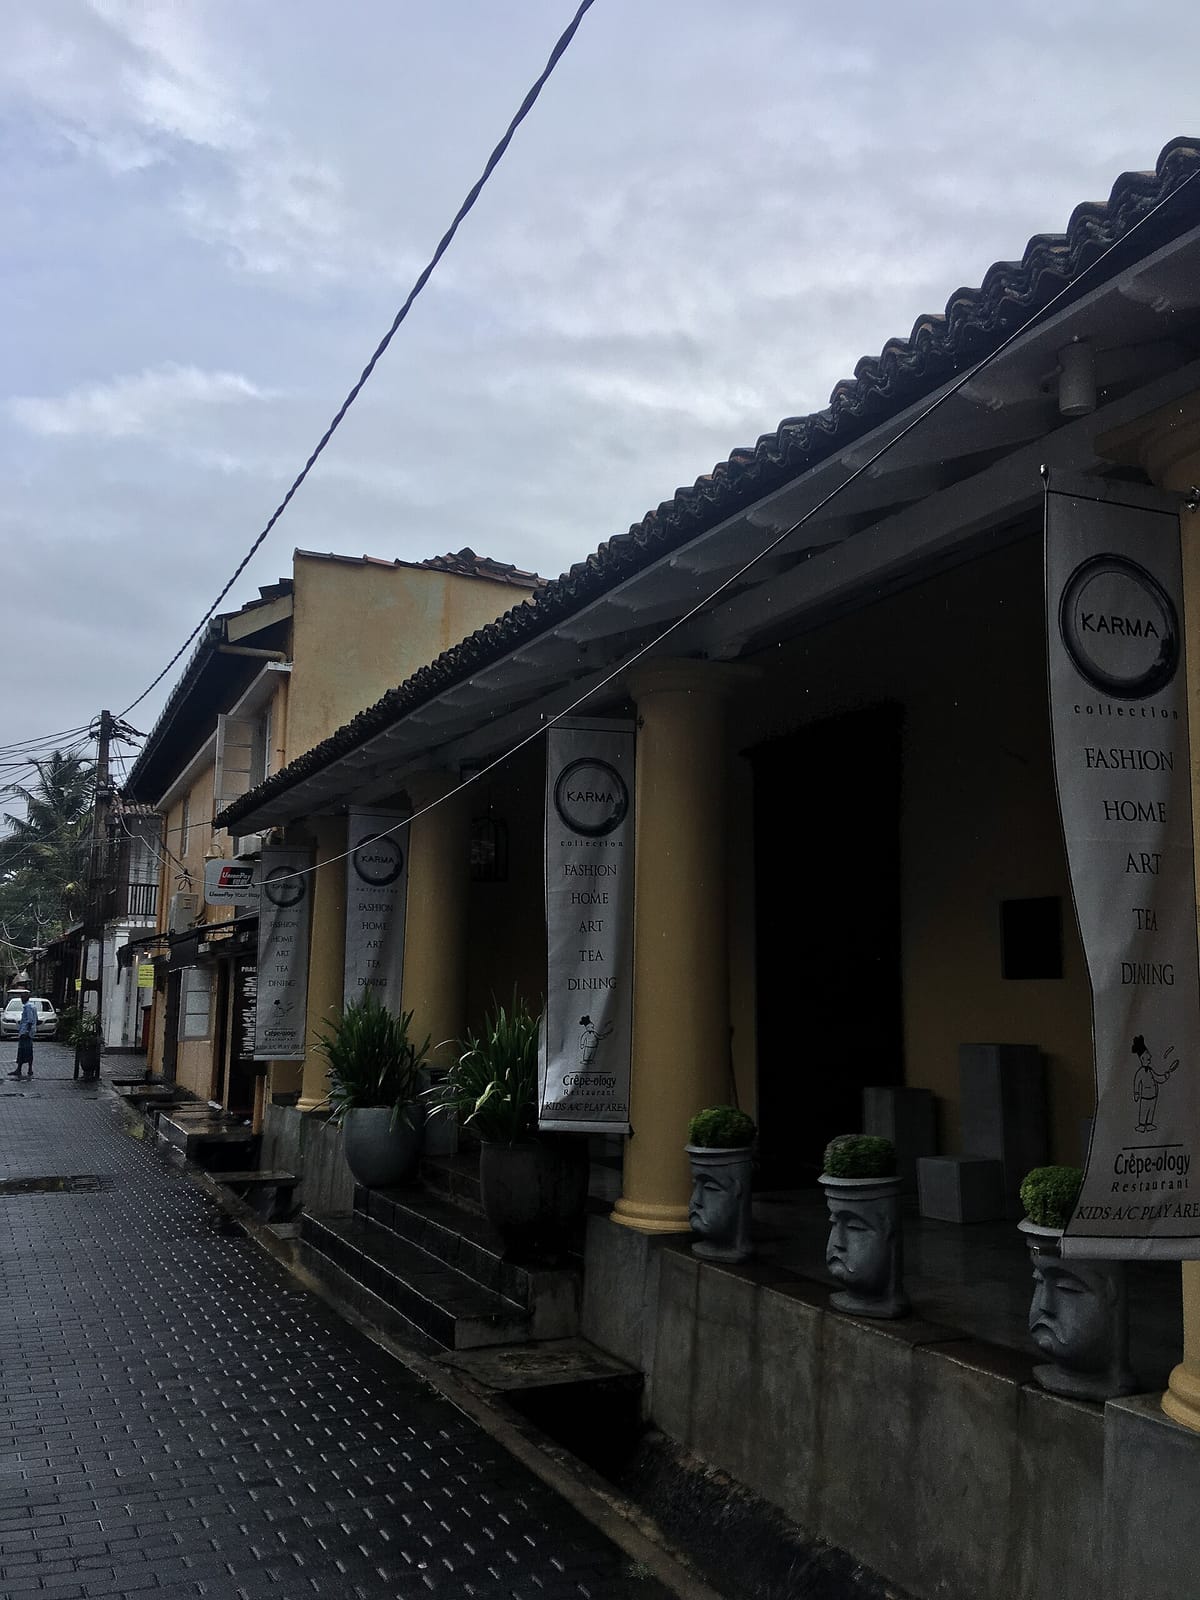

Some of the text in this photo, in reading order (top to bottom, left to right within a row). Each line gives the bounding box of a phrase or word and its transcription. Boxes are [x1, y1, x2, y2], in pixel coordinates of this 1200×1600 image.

[1081, 612, 1159, 640] KARMA
[1074, 704, 1179, 720] collection
[1085, 747, 1175, 772] FASHION
[567, 791, 615, 803] KARMA
[1103, 800, 1167, 823] HOME
[361, 855, 395, 865] KARMA
[1125, 852, 1162, 875] ART
[564, 864, 617, 877] FASHION
[571, 892, 609, 905] HOME
[358, 903, 393, 913] FASHION
[362, 921, 388, 930] HOME
[579, 920, 604, 933] ART
[1132, 908, 1159, 932] TEA
[366, 940, 384, 949] ART
[579, 950, 604, 962] TEA
[1120, 961, 1175, 986] DINING
[568, 976, 617, 991] DINING
[1114, 1150, 1191, 1178] Crêpe-ology
[1111, 1178, 1189, 1193] Restaurant
[1075, 1202, 1200, 1220] KIDS A/C PLAY ARE
